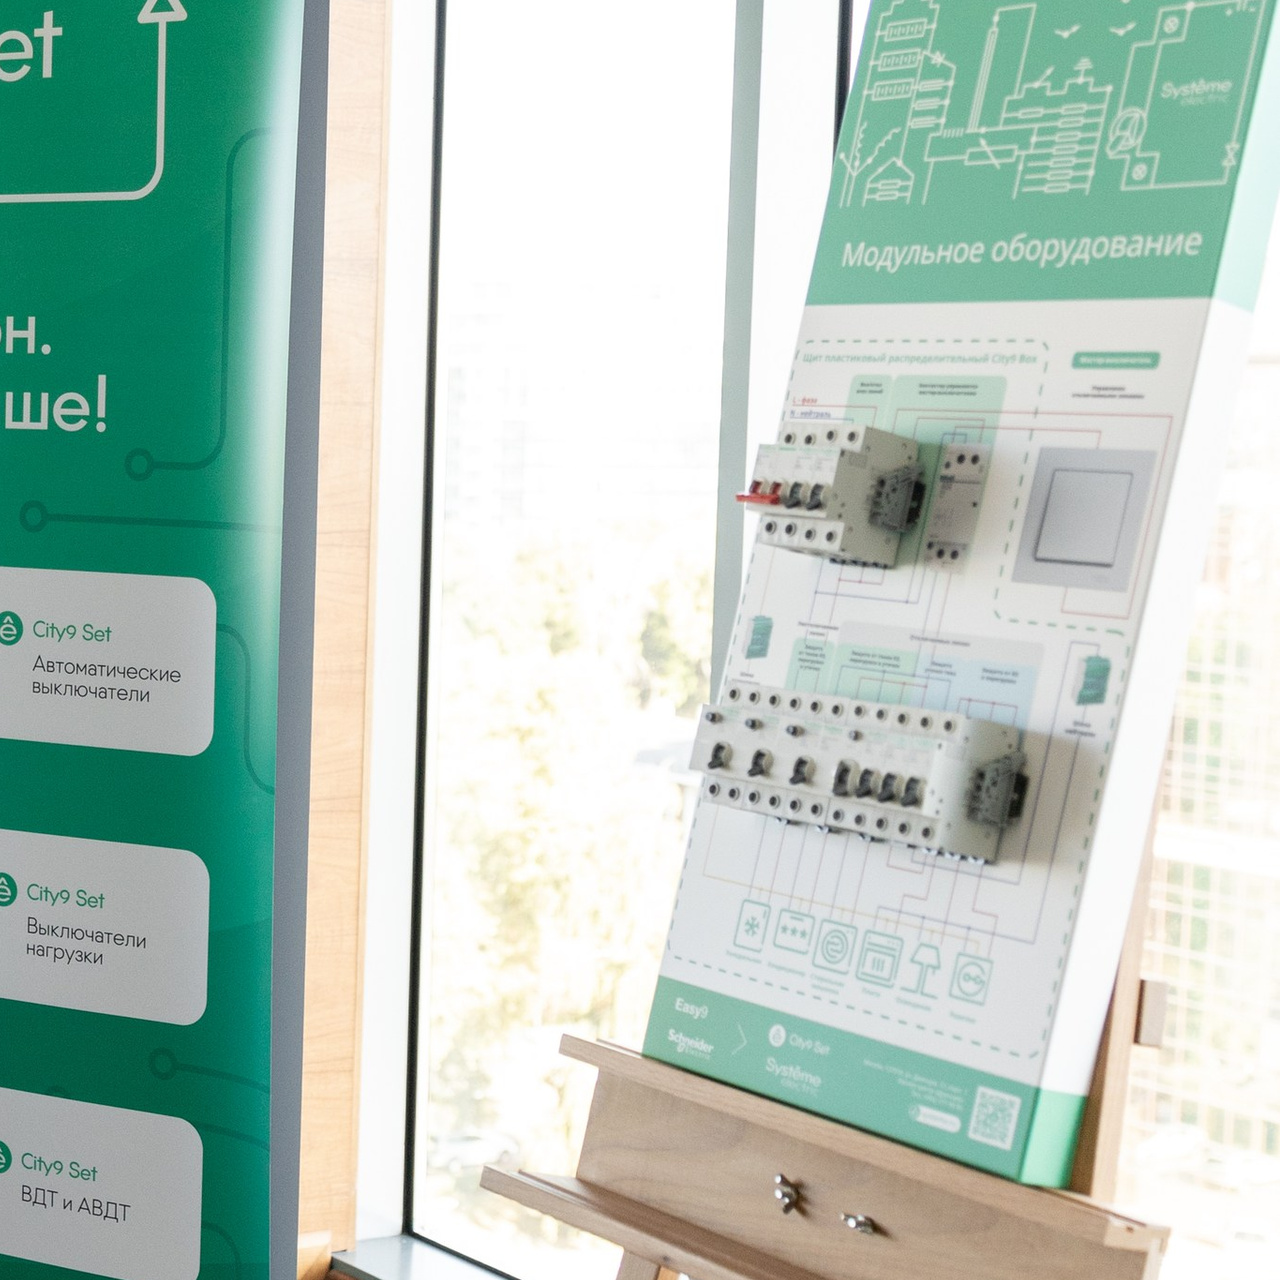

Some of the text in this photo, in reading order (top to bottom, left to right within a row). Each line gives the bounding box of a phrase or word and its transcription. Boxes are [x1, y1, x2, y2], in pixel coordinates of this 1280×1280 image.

[841, 232, 1203, 274] Модульное оборудование
[33, 620, 77, 642] City9
[82, 623, 112, 642] Set
[32, 655, 181, 683] Автоматические
[32, 681, 150, 703] выключатели
[27, 883, 70, 906] City9
[76, 889, 105, 909] Set
[27, 916, 147, 949] Выключатели
[26, 943, 103, 965] нагрузки
[675, 997, 708, 1019] Easy9
[668, 1029, 714, 1053] Schneider
[21, 1152, 63, 1177] City9
[69, 1162, 98, 1182] Set
[21, 1184, 131, 1223] ВДТ и АВДТ
